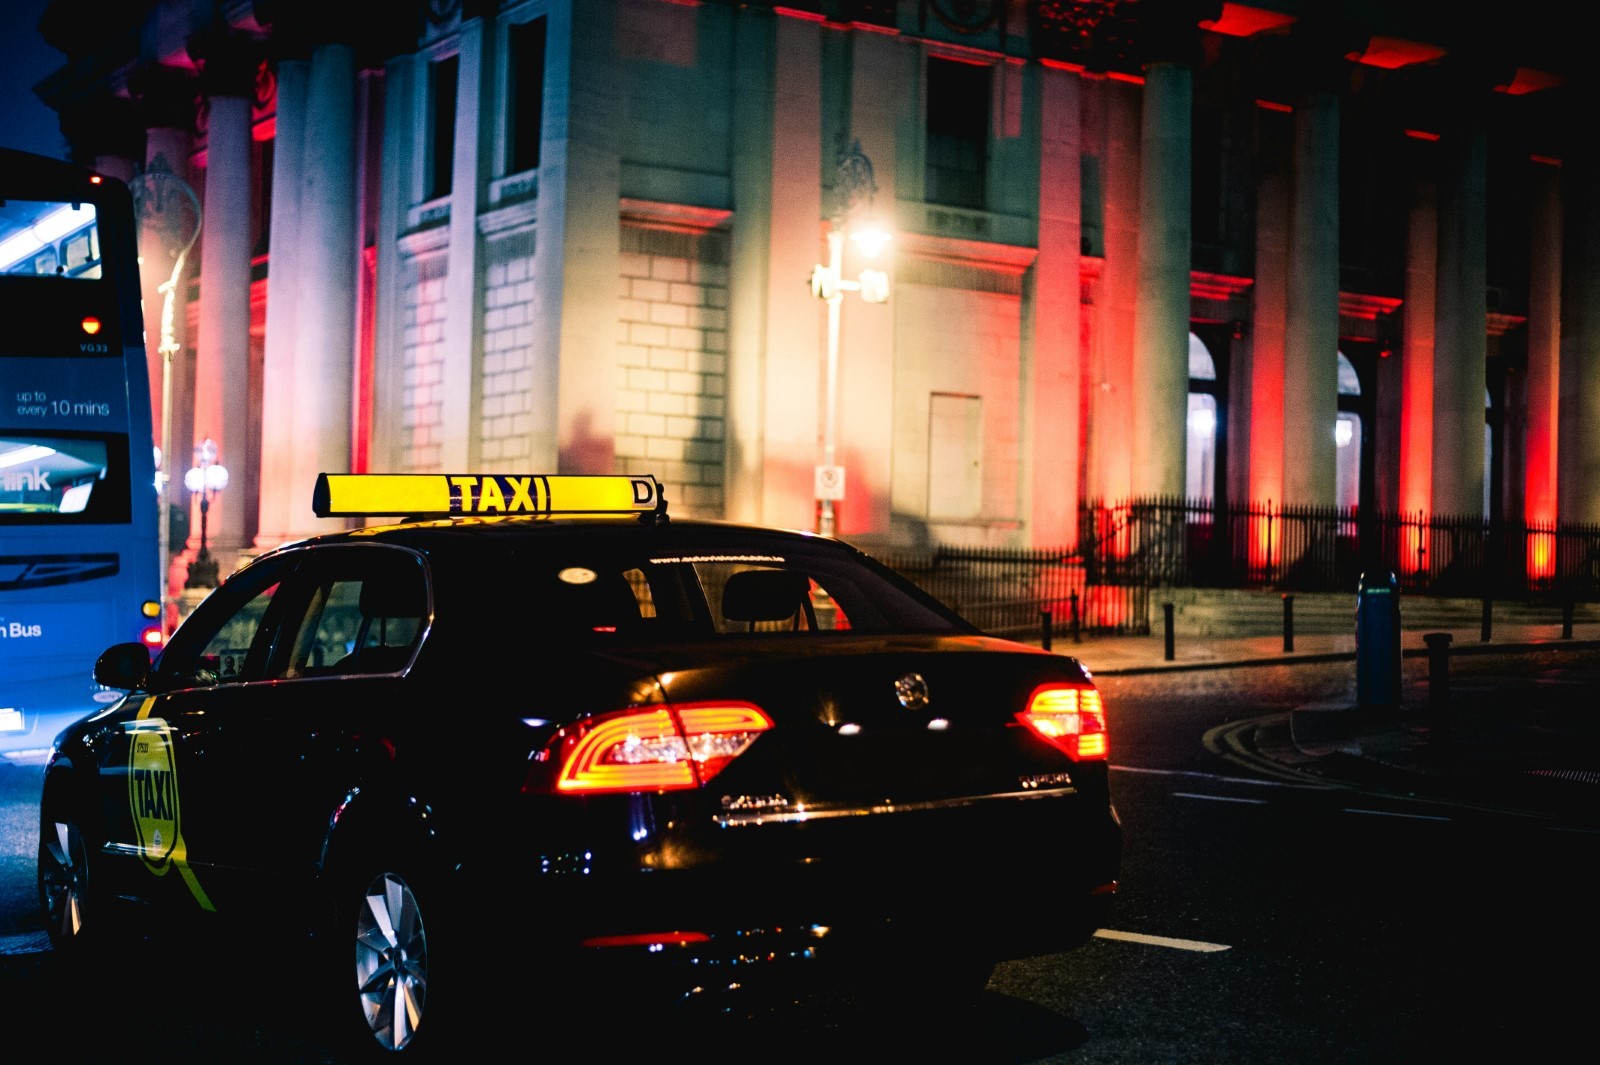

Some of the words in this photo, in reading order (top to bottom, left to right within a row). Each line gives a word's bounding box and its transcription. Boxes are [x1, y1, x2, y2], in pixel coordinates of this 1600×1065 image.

[16, 392, 32, 404] up
[34, 390, 46, 402] to
[17, 405, 48, 418] every
[51, 400, 70, 416] 10
[74, 400, 110, 417] mins
[450, 476, 546, 512] TAXI
[631, 480, 653, 504] D
[9, 622, 42, 638] Bus
[135, 769, 174, 821] TAXI
